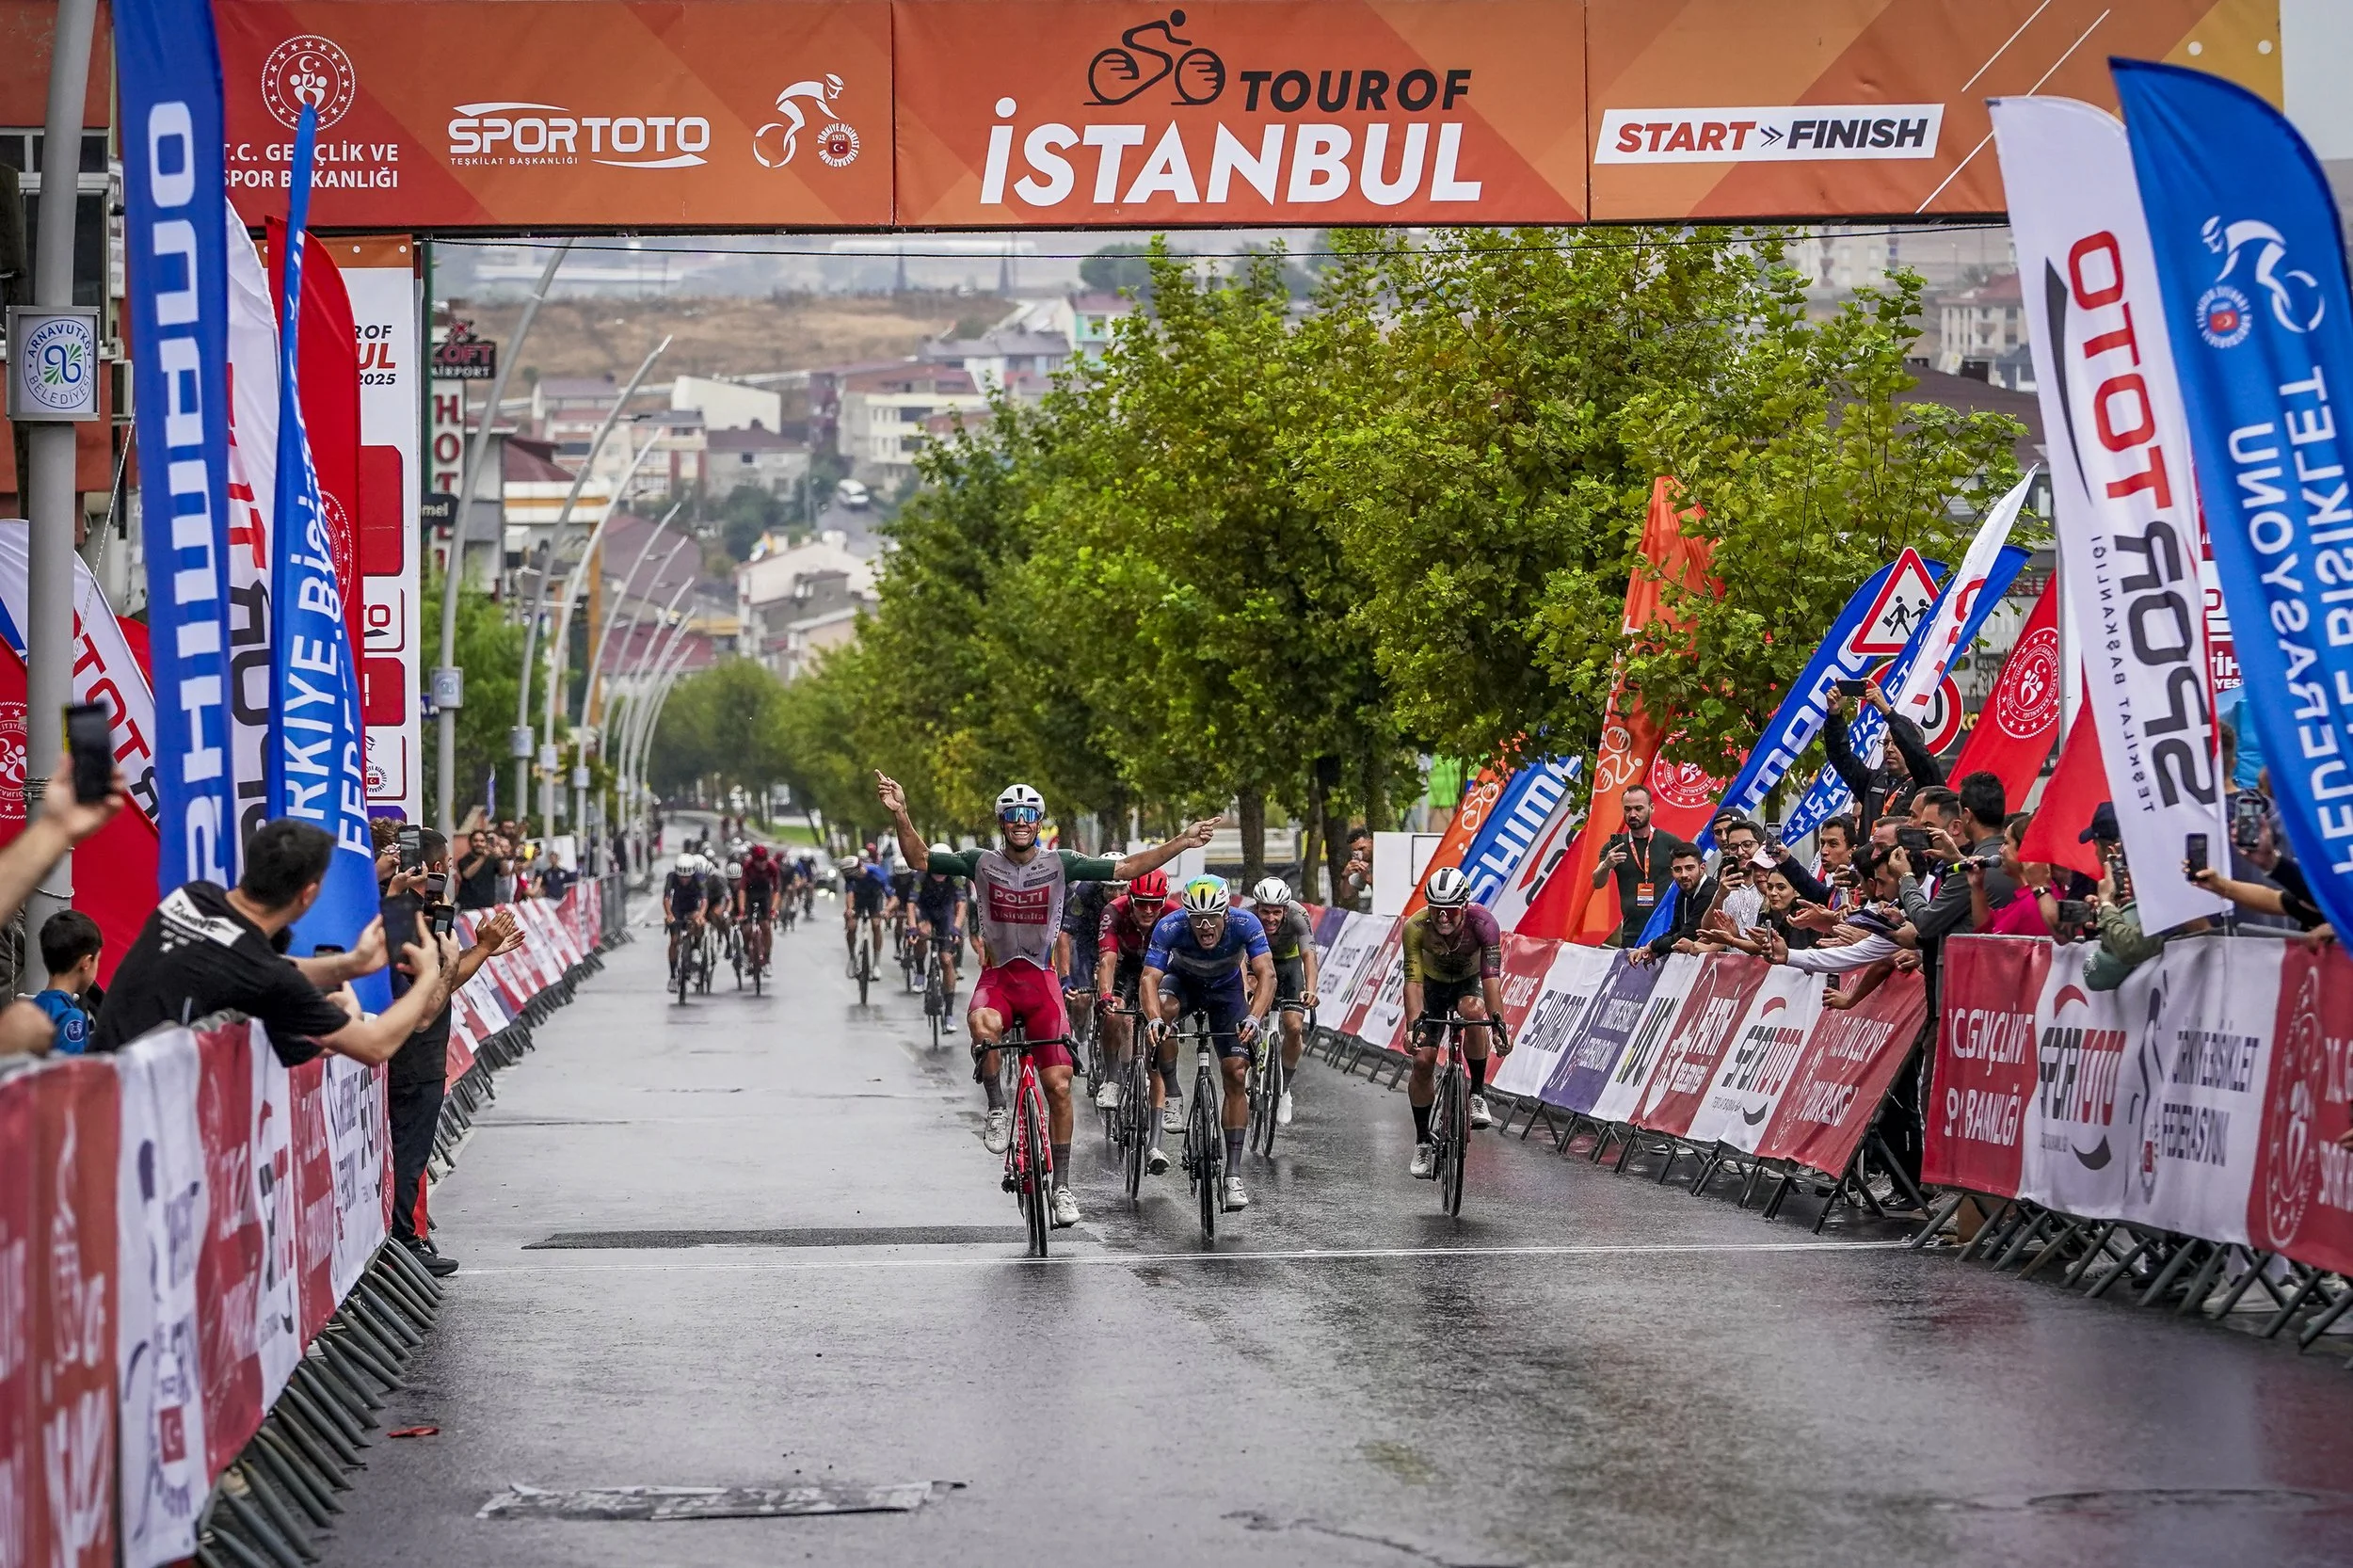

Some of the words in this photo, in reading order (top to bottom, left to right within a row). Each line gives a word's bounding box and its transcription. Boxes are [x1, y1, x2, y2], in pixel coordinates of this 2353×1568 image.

[1615, 120, 1757, 153] START
[1786, 118, 1929, 151] FINISH
[265, 140, 364, 167] GEÇLİK
[370, 143, 398, 162] VE
[450, 156, 504, 167] TEŞKİLAT
[509, 155, 578, 167] BAŞKANLIĞI
[980, 97, 1483, 207] İSTANBUL
[280, 166, 399, 188] BKANLIĞI
[28, 324, 92, 359] ARNAVUTKÖY
[994, 889, 1043, 904] POLTI
